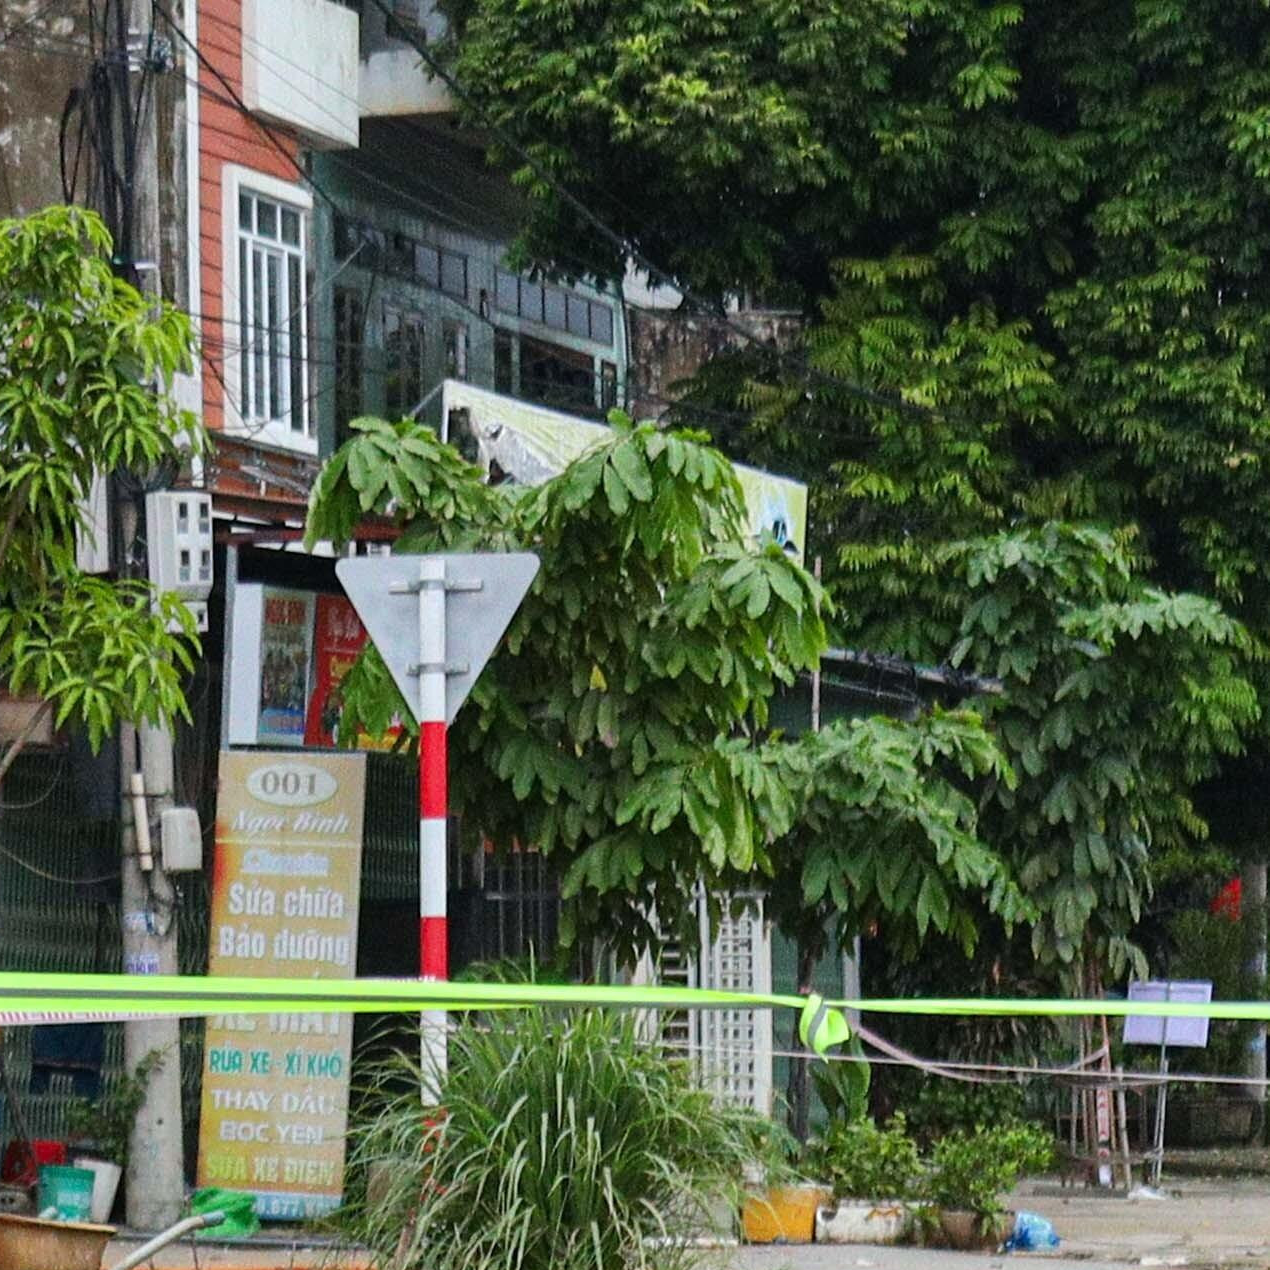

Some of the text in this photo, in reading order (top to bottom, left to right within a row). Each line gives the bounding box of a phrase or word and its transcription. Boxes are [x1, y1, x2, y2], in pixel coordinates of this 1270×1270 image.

[261, 770, 317, 796] 001
[229, 880, 346, 919] Sửa chữa
[219, 922, 350, 966] Bảo dưỡng
[249, 1050, 271, 1074] XE
[211, 1088, 276, 1112] THAY
